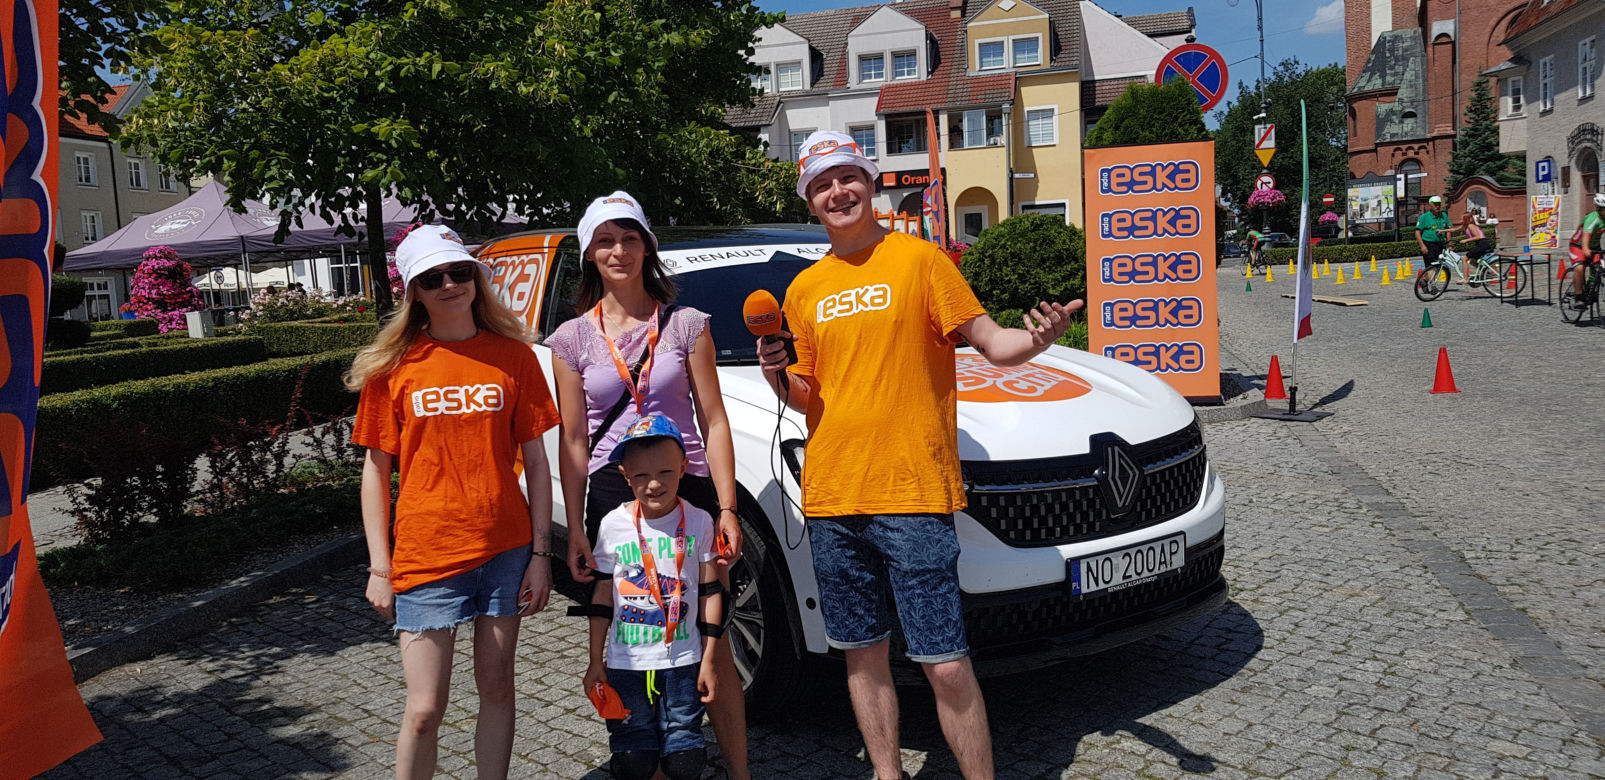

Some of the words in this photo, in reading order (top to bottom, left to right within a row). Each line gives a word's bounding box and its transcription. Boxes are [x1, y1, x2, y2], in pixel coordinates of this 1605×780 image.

[902, 174, 943, 185] Oran
[1538, 162, 1549, 181] P
[686, 248, 767, 264] RENAULT
[658, 535, 696, 559] PLY
[1086, 557, 1113, 589] NO
[1122, 540, 1179, 580] 200AP
[1072, 582, 1080, 590] PL
[615, 619, 690, 645] FOOTBLL
